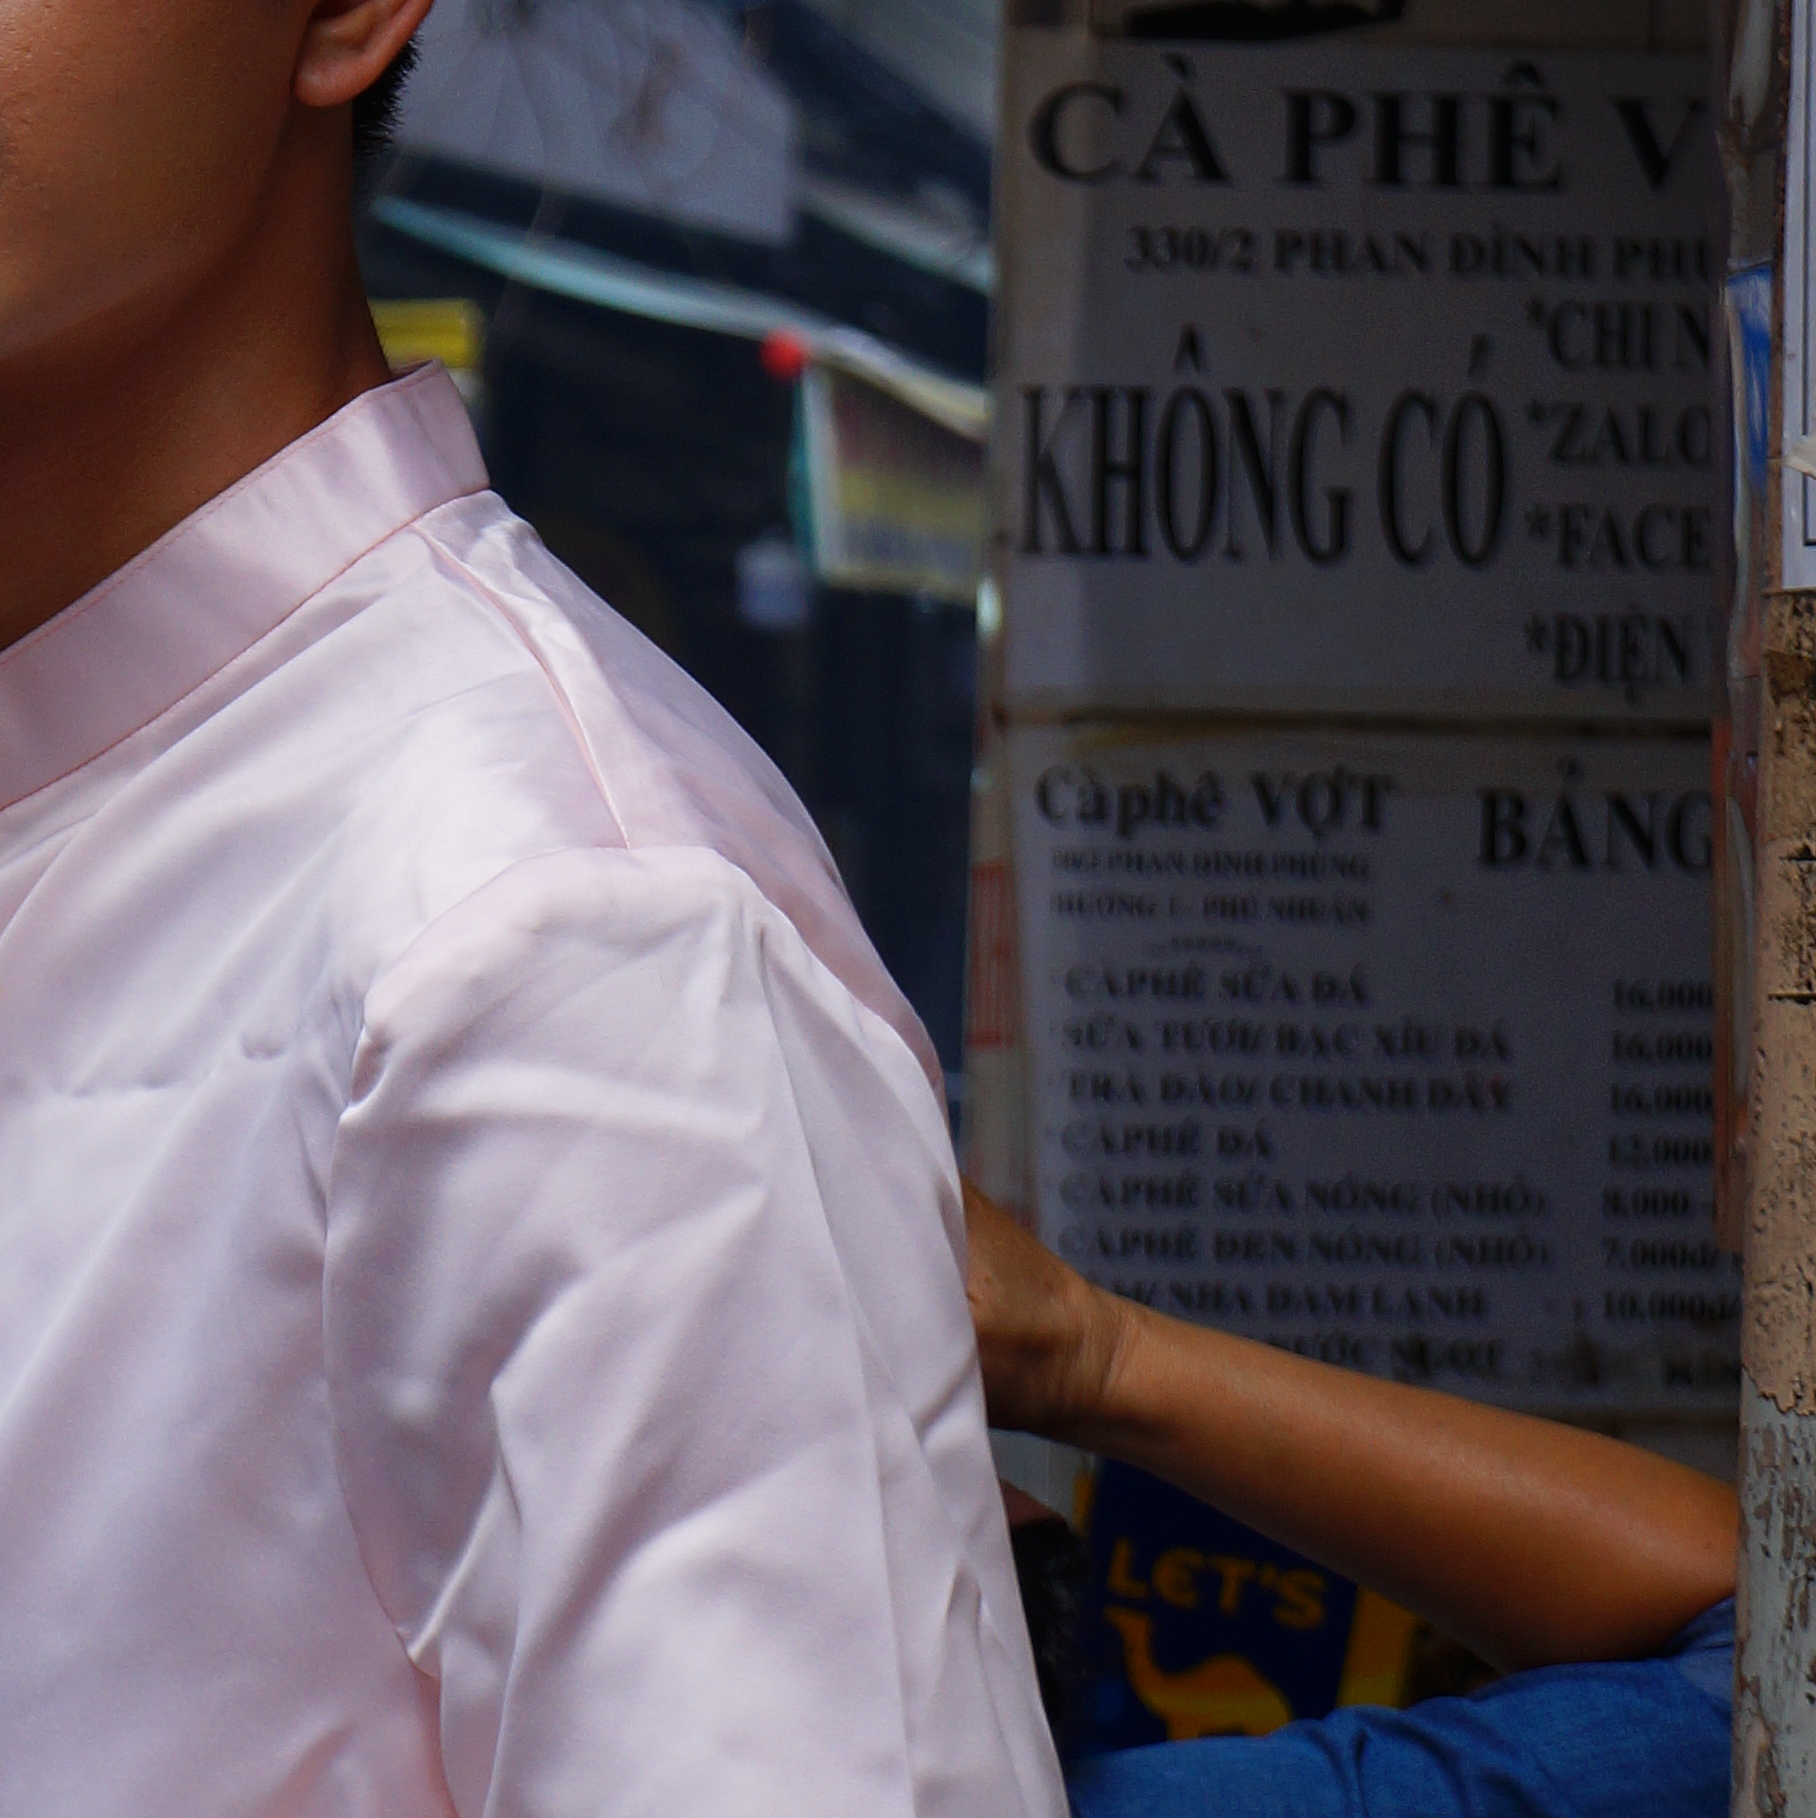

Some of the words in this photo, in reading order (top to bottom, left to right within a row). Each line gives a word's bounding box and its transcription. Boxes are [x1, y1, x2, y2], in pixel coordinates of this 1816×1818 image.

[1028, 53, 1226, 183] CÀ
[1282, 61, 1565, 193] PHÊ
[1124, 225, 1255, 274] 330/2
[1272, 228, 1433, 275] PHAN
[1016, 324, 1355, 567] KHÔNG
[1377, 334, 1508, 568] CÓ
[1250, 765, 1396, 840] VỢT
[1269, 1075, 1420, 1111] CHANH
[1106, 1536, 1329, 1631] LET'S
